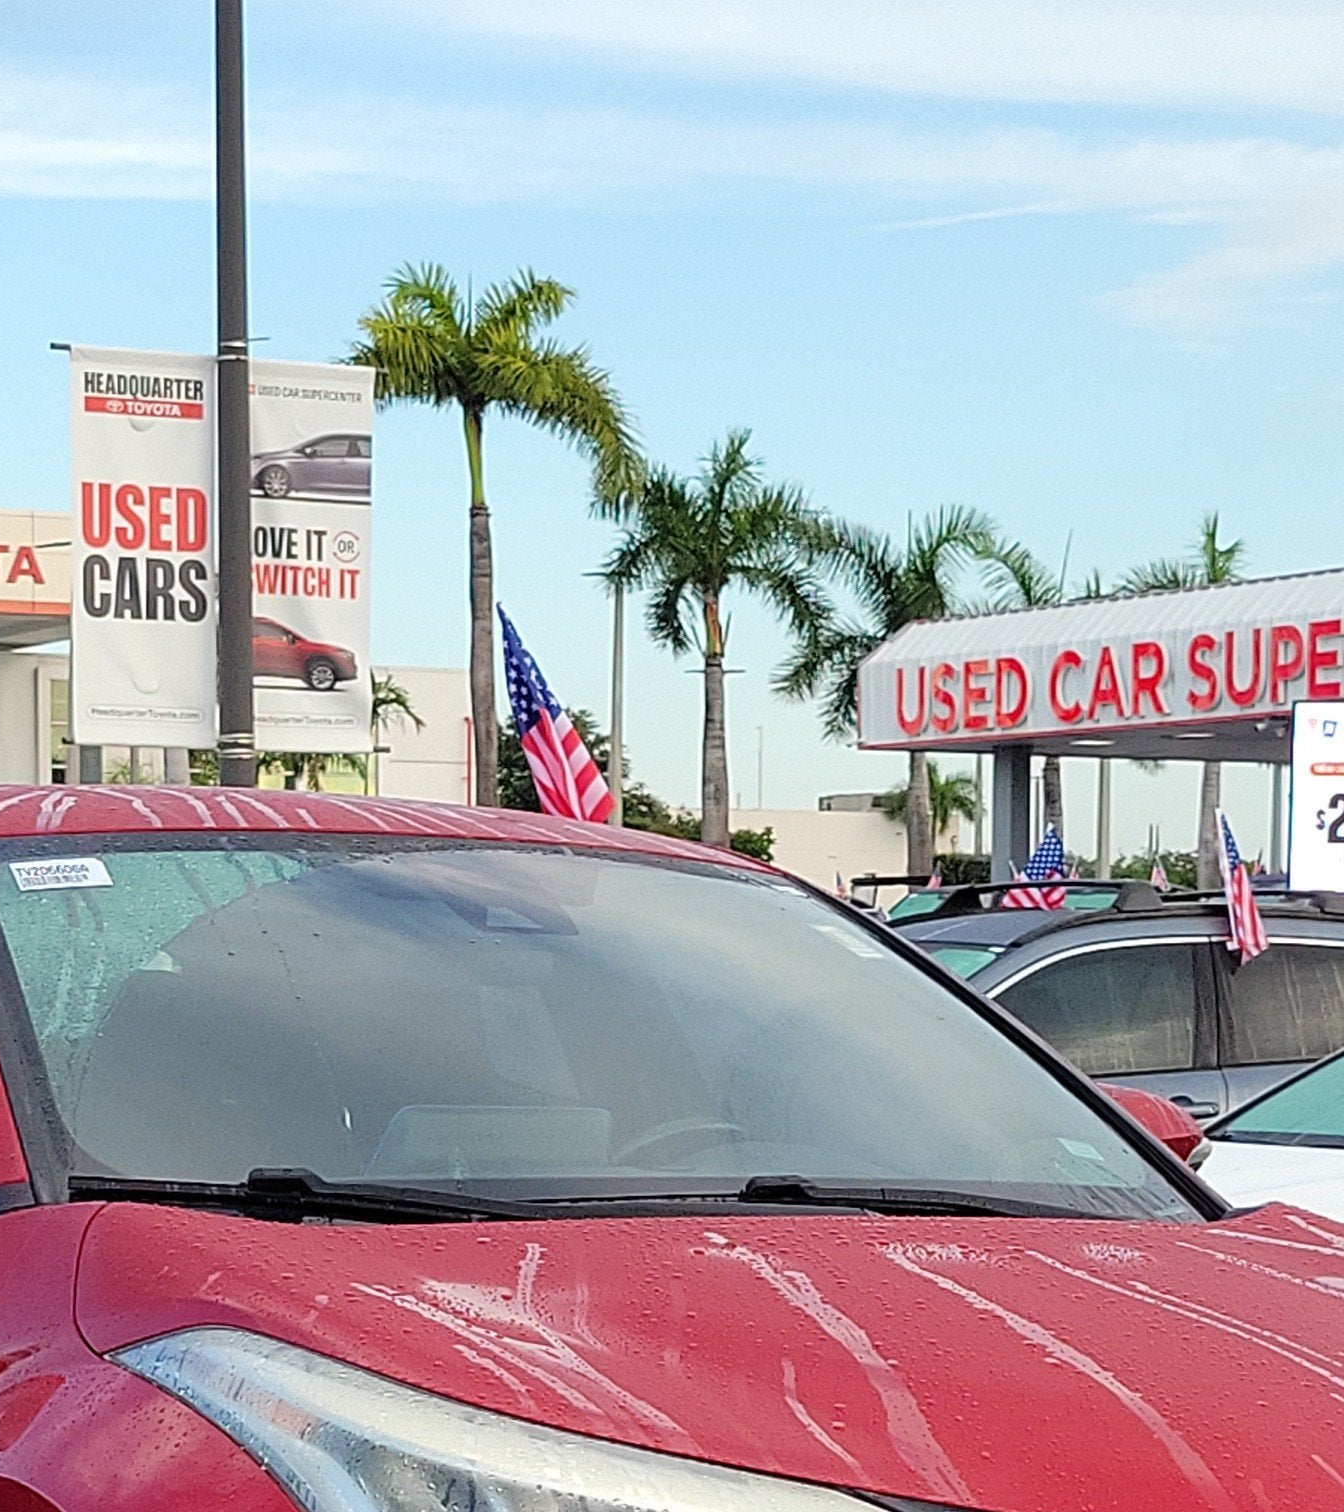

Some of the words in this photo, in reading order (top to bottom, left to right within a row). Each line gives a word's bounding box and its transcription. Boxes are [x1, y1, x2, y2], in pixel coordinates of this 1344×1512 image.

[83, 371, 204, 401] HEADQUARTER
[126, 401, 182, 417] TOYOTA
[81, 482, 207, 552] USED
[253, 526, 298, 560] OVE
[306, 529, 327, 562] IT
[337, 539, 356, 555] OR
[82, 554, 207, 622] CARS
[252, 564, 331, 598] WITCH
[339, 568, 360, 600] IT
[895, 656, 1030, 735] USED
[1050, 641, 1170, 723] CAR
